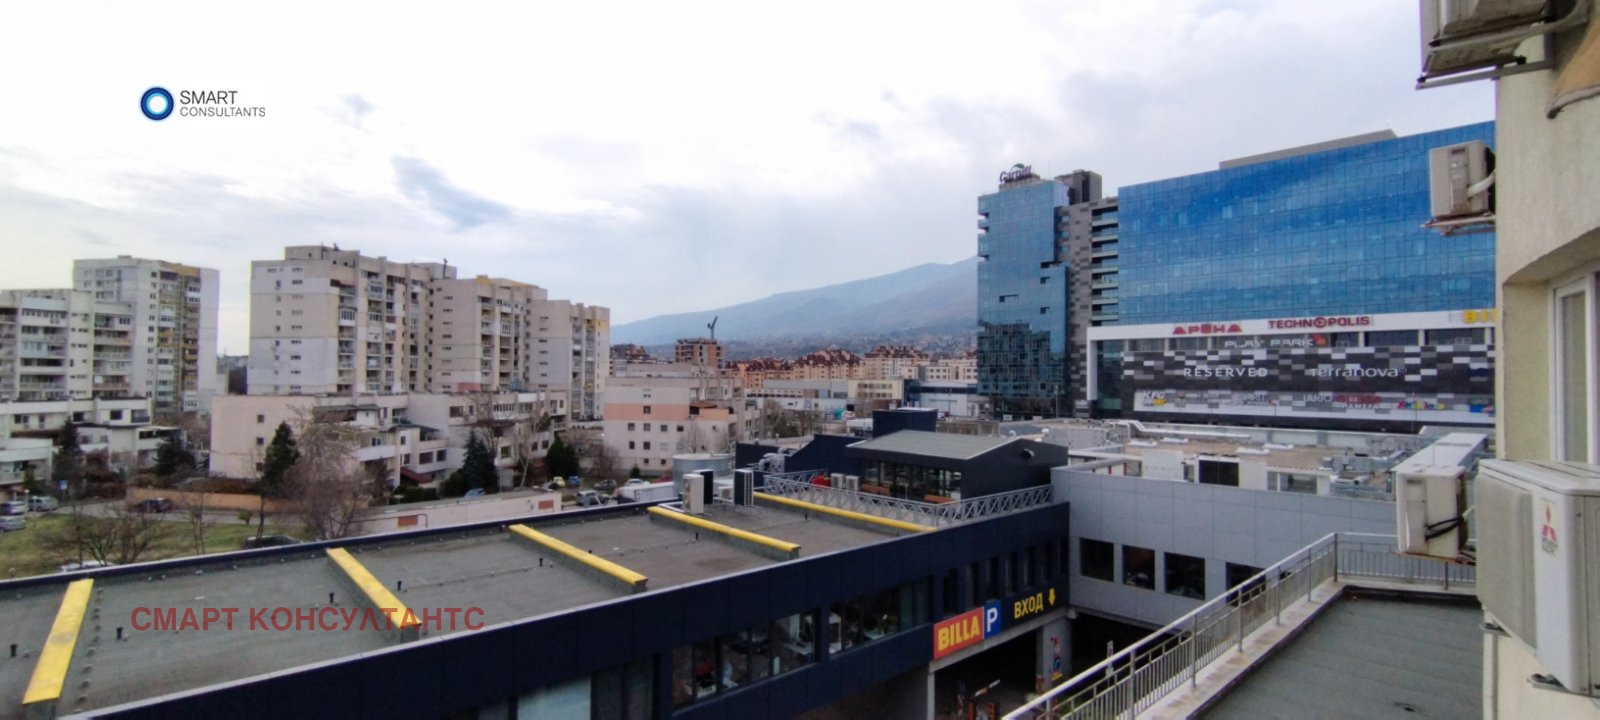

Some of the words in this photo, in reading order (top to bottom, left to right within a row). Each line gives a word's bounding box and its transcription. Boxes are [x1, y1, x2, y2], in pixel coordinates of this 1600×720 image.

[1268, 316, 1370, 329] TECHNOPOLIS
[1269, 337, 1314, 347] PARK
[1183, 367, 1269, 378] RESERVED
[1013, 593, 1044, 619] ВХОД
[986, 607, 998, 632] P
[937, 616, 980, 651] BILLA
